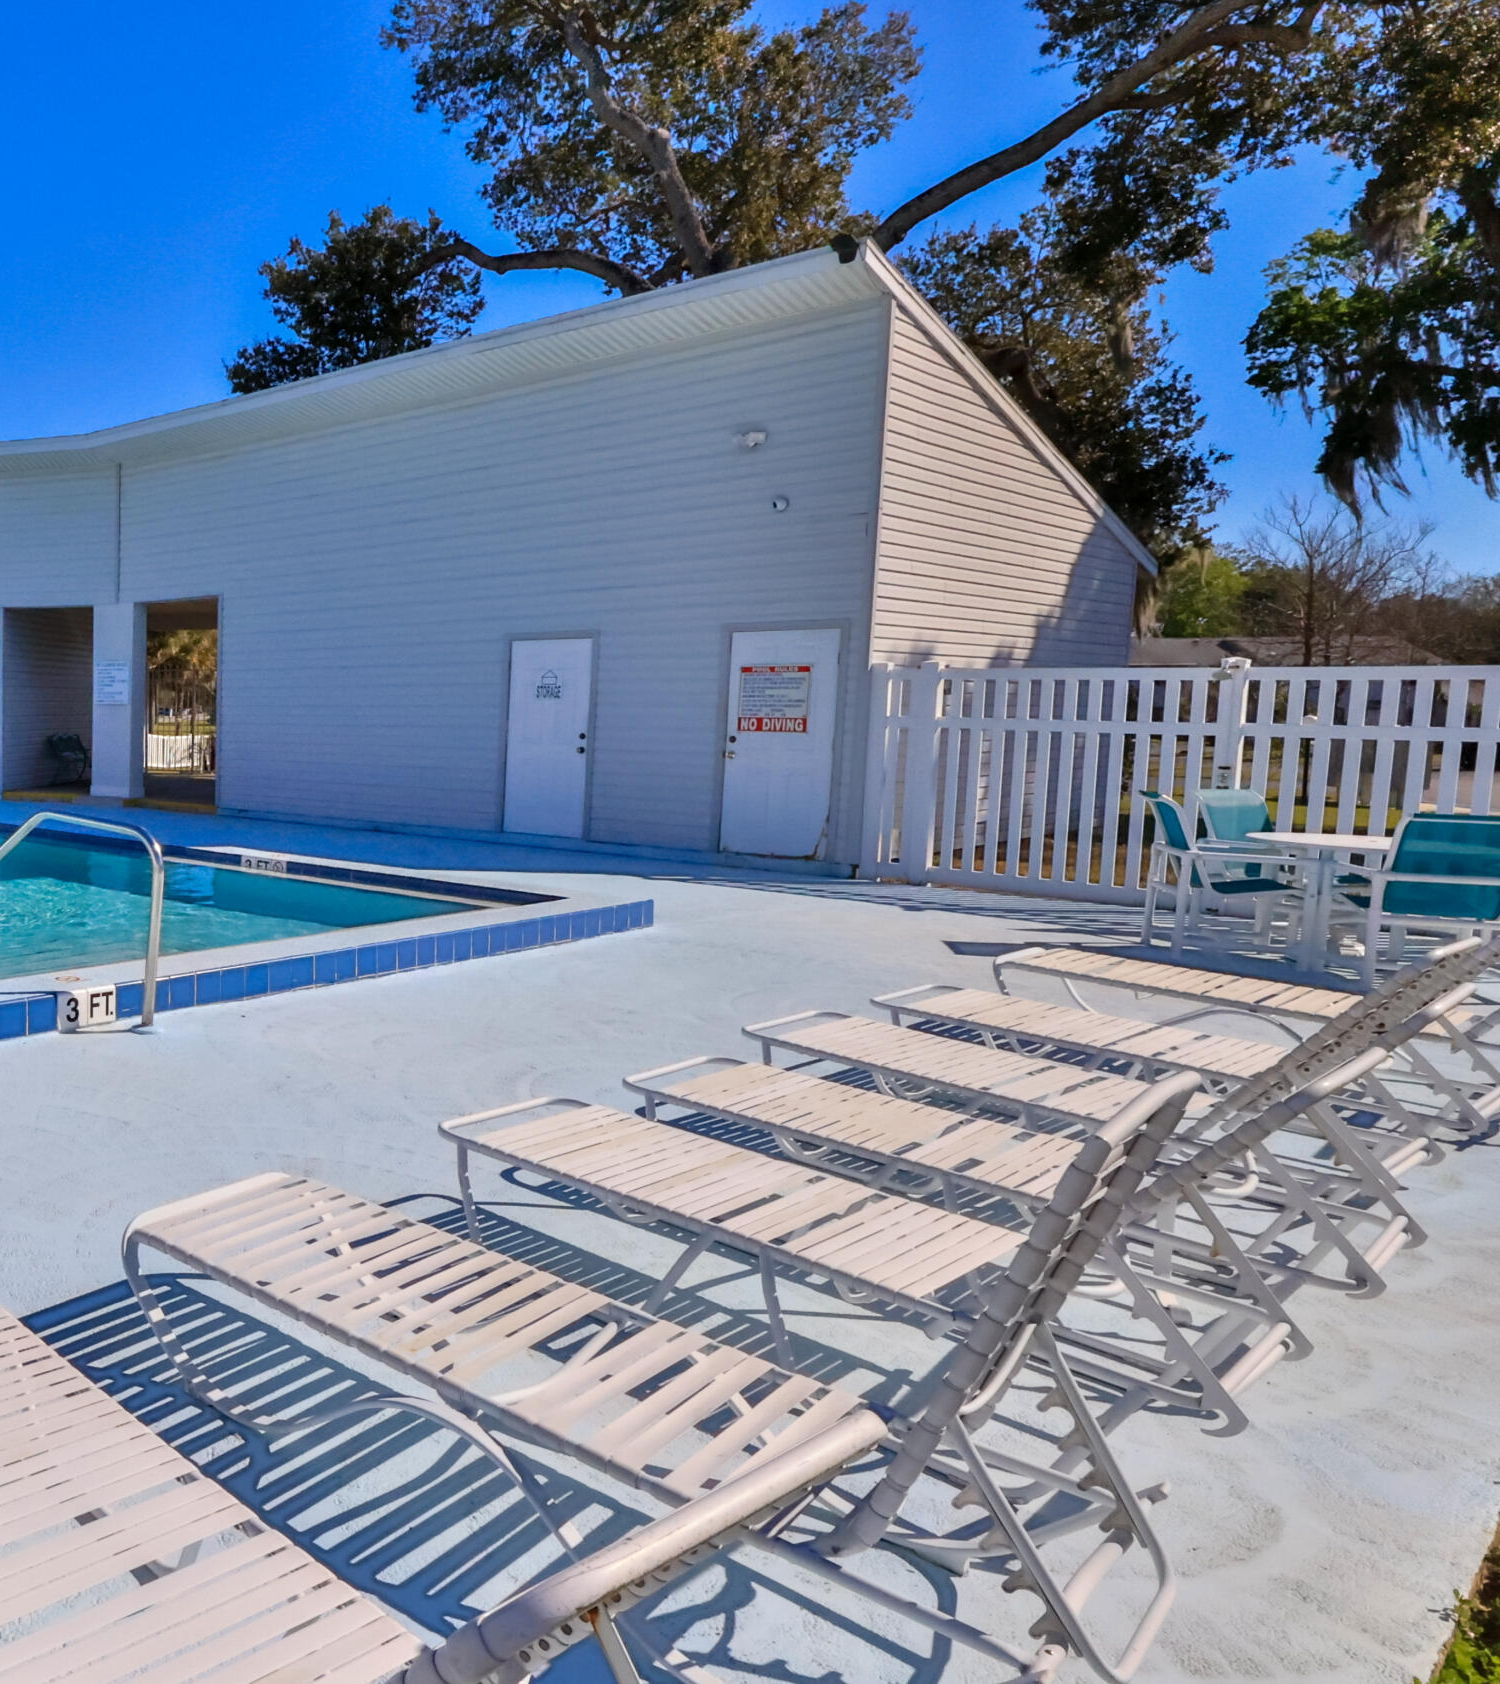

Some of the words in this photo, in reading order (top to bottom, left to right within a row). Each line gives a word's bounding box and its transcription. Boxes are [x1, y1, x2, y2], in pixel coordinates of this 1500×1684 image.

[536, 685, 561, 699] STORAGE
[740, 718, 757, 731] NO
[762, 718, 804, 732] DIVING
[66, 997, 79, 1022] 3
[90, 991, 113, 1018] FT.
